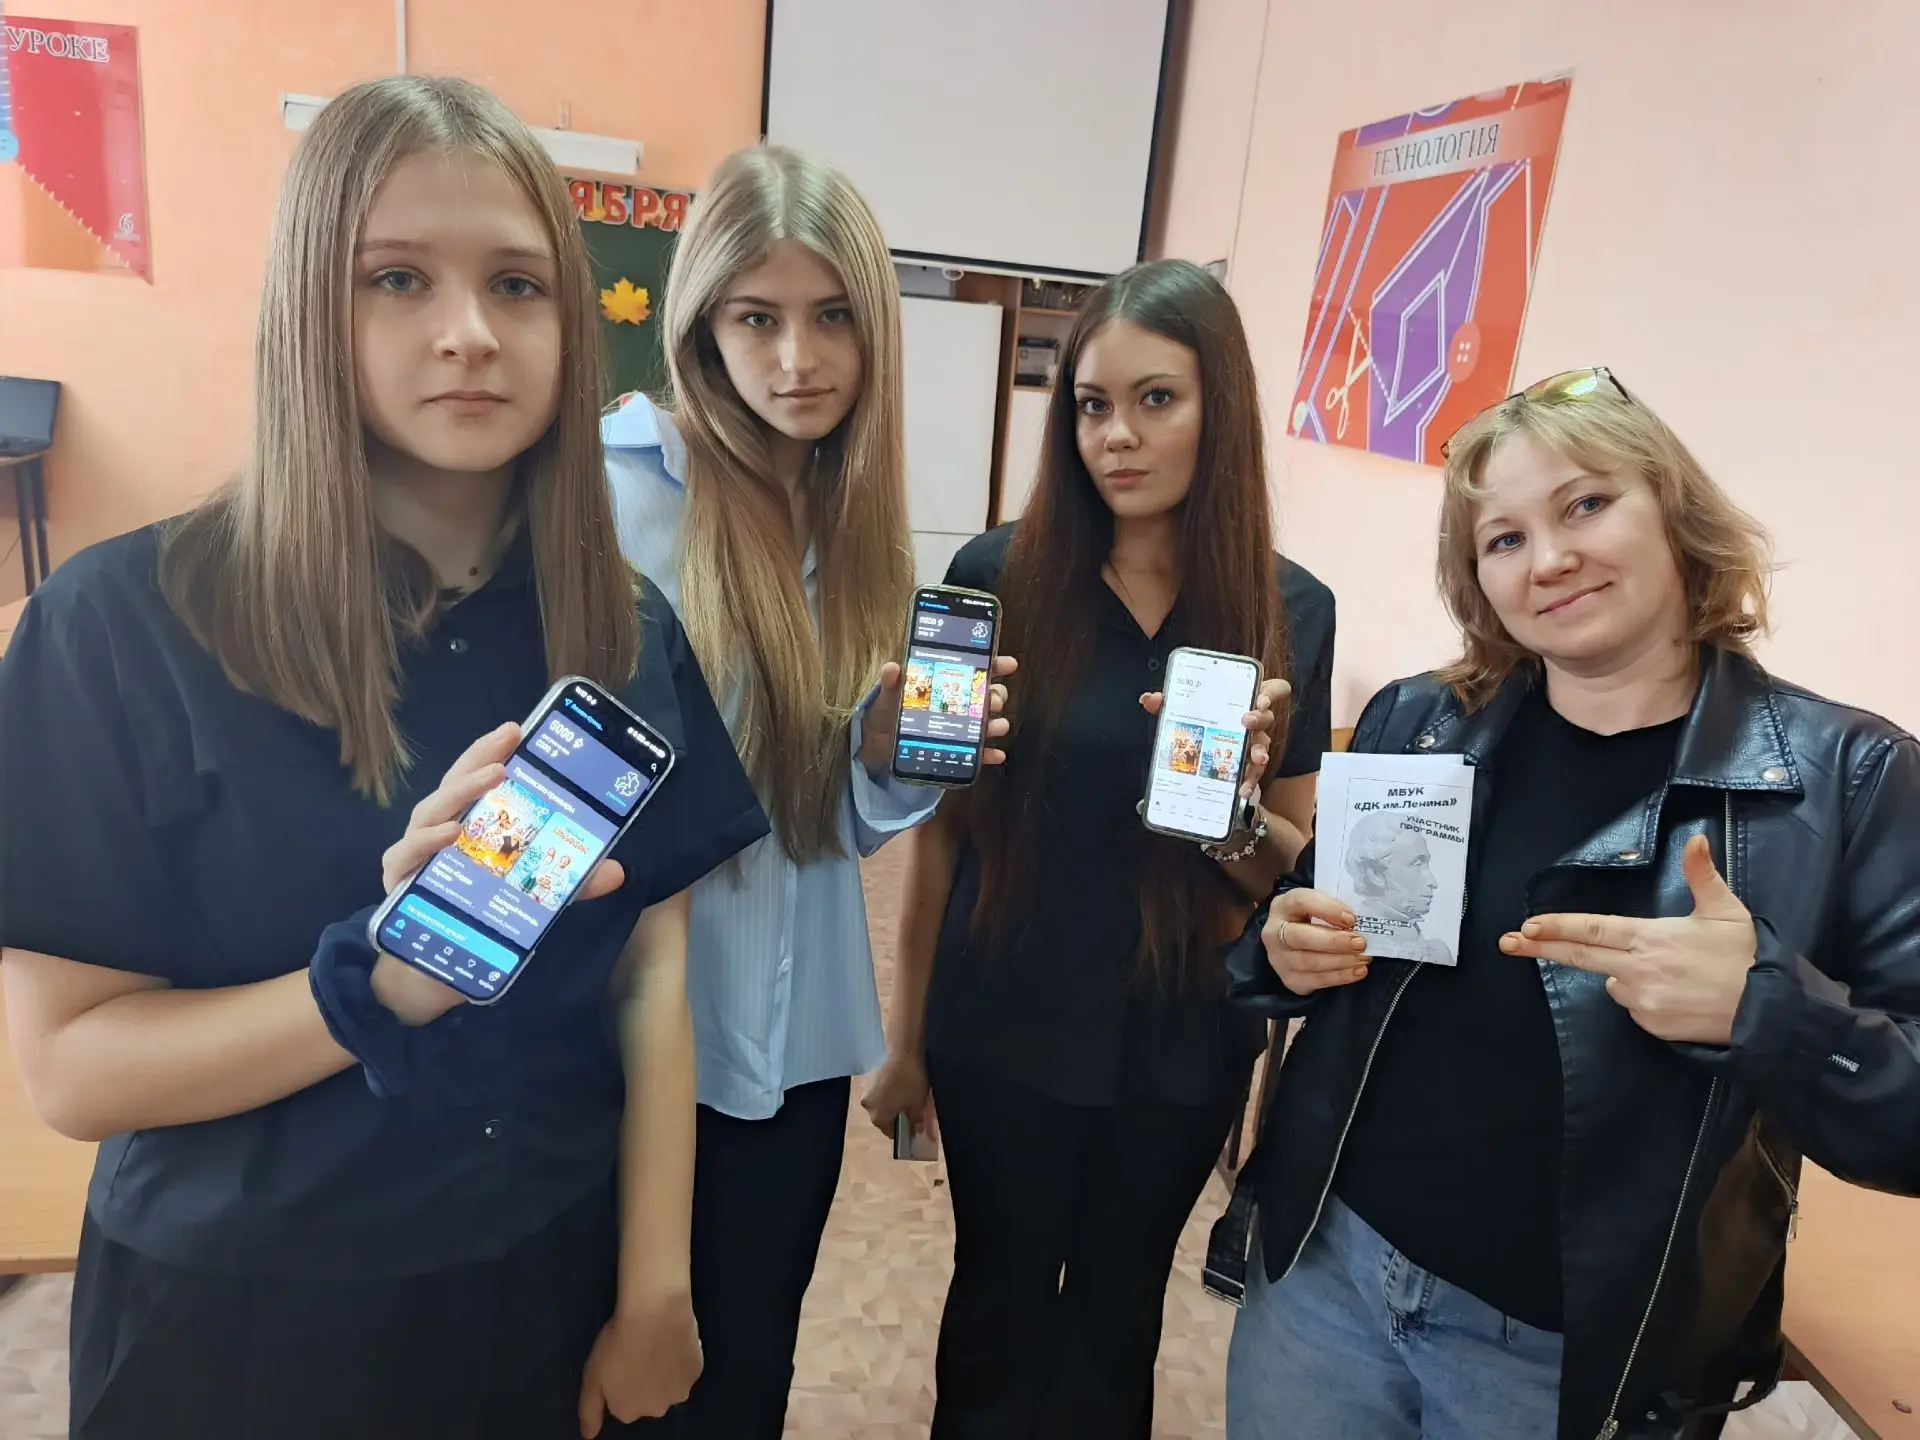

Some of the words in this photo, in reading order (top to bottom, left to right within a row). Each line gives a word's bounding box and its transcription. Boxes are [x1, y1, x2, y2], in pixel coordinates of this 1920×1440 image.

[4, 25, 110, 63] УРОКЕ
[1373, 123, 1500, 177] ТЕХНОЛОГИЯ
[1387, 786, 1425, 798] МБУК
[1354, 801, 1380, 812] «ДК
[1400, 822, 1465, 844] ПРОГРАММЫ
[1406, 814, 1461, 834] УЧАСТНИК
[1355, 915, 1412, 929] УШКИН
